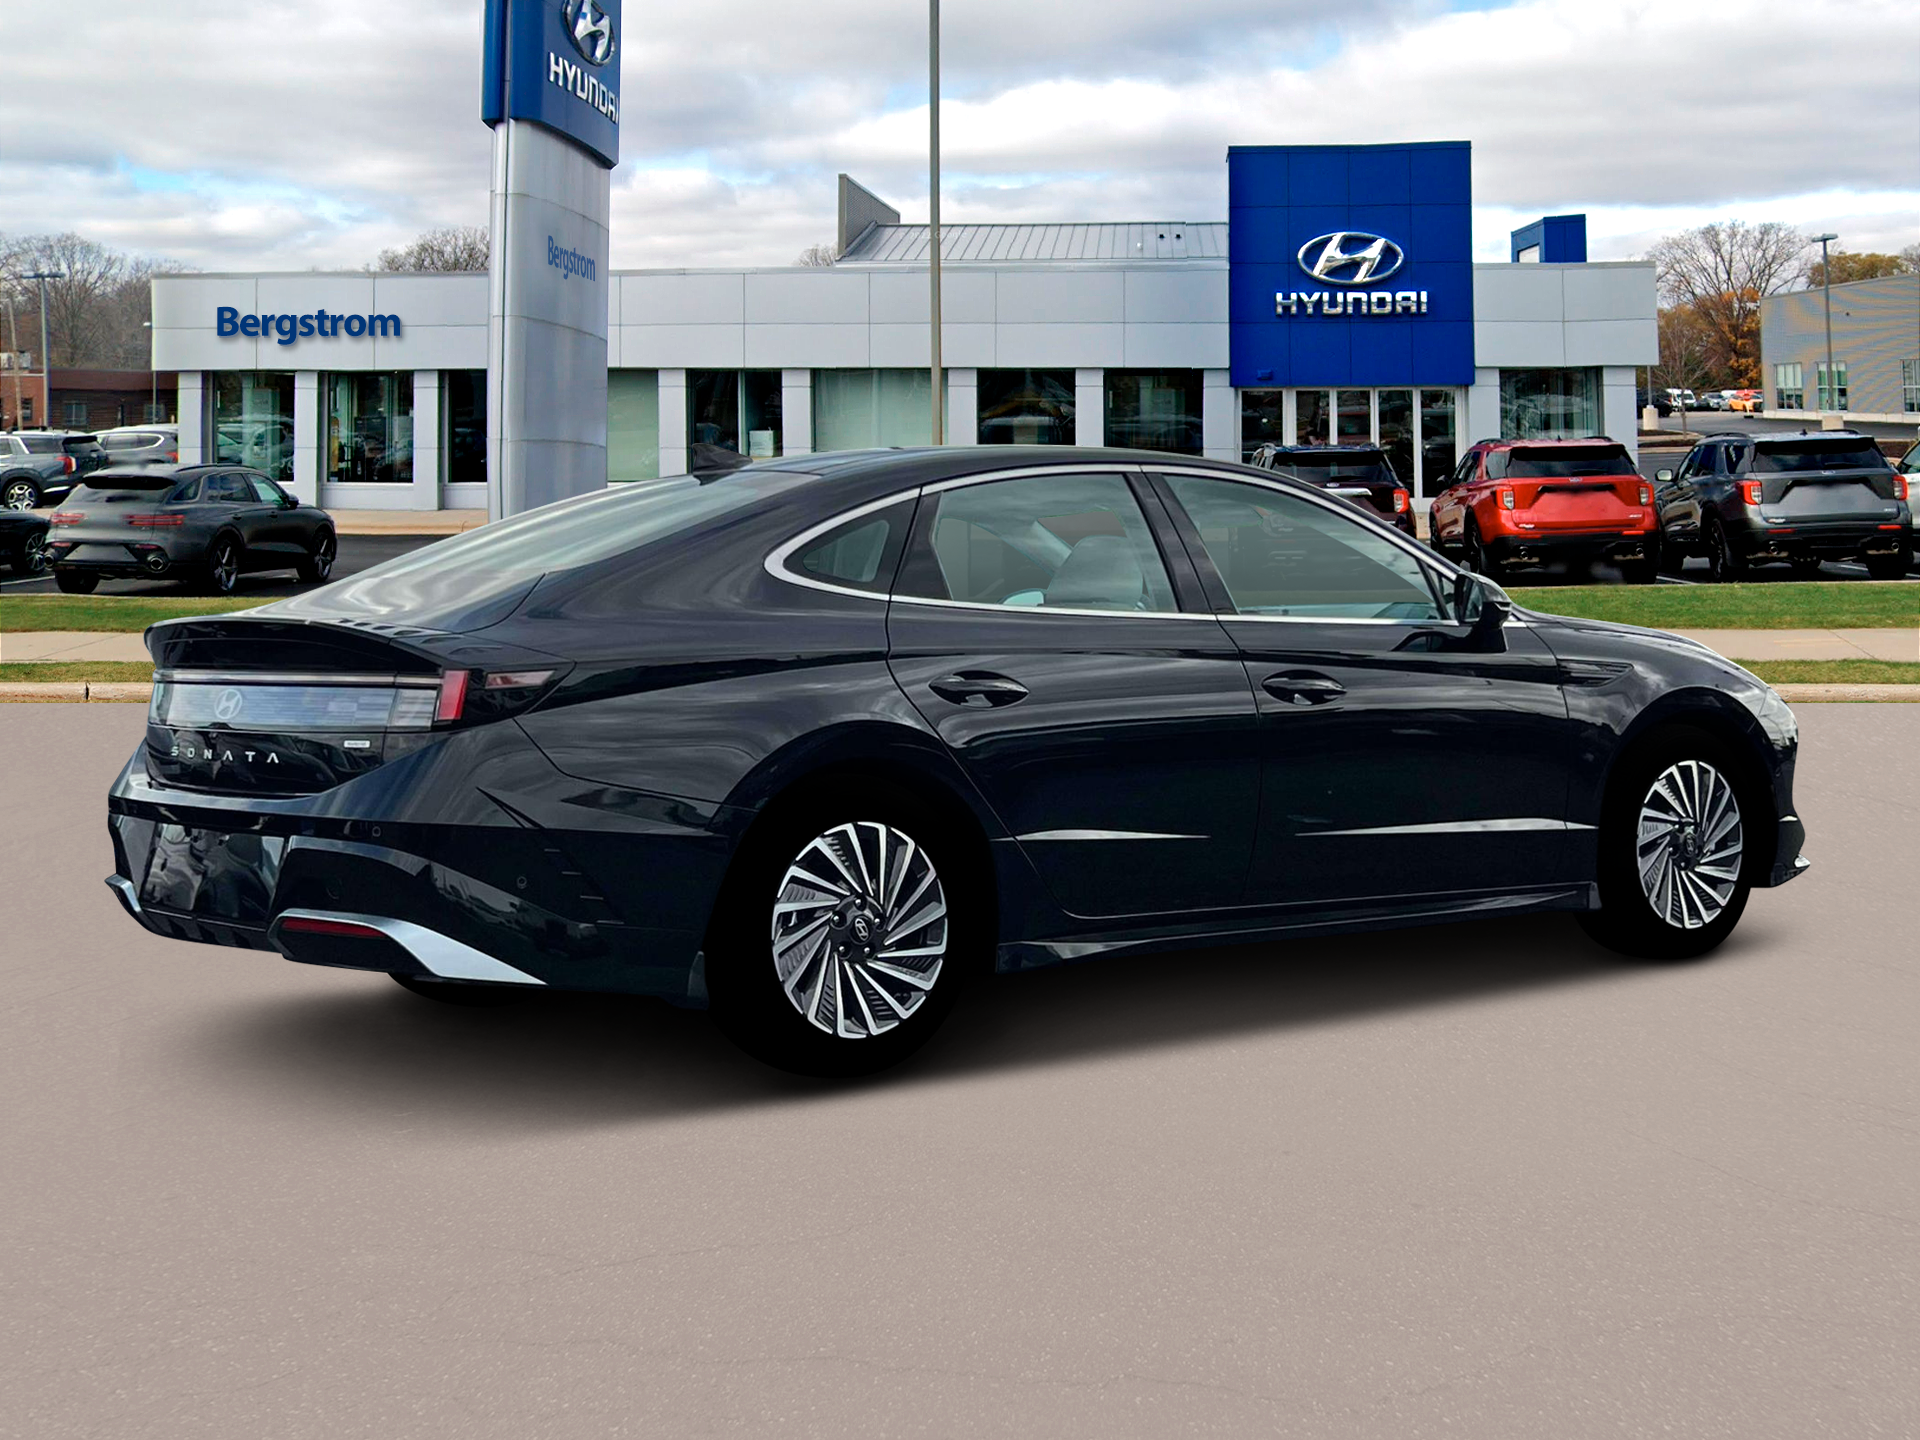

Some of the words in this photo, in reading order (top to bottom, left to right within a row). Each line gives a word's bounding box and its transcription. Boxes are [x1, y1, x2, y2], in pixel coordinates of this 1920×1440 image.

[549, 51, 619, 124] HYUNDAI
[548, 235, 596, 282] Bergstrom
[1275, 290, 1428, 315] HYUNDAI
[217, 306, 401, 346] Bergstrom
[171, 746, 279, 764] SONATA
